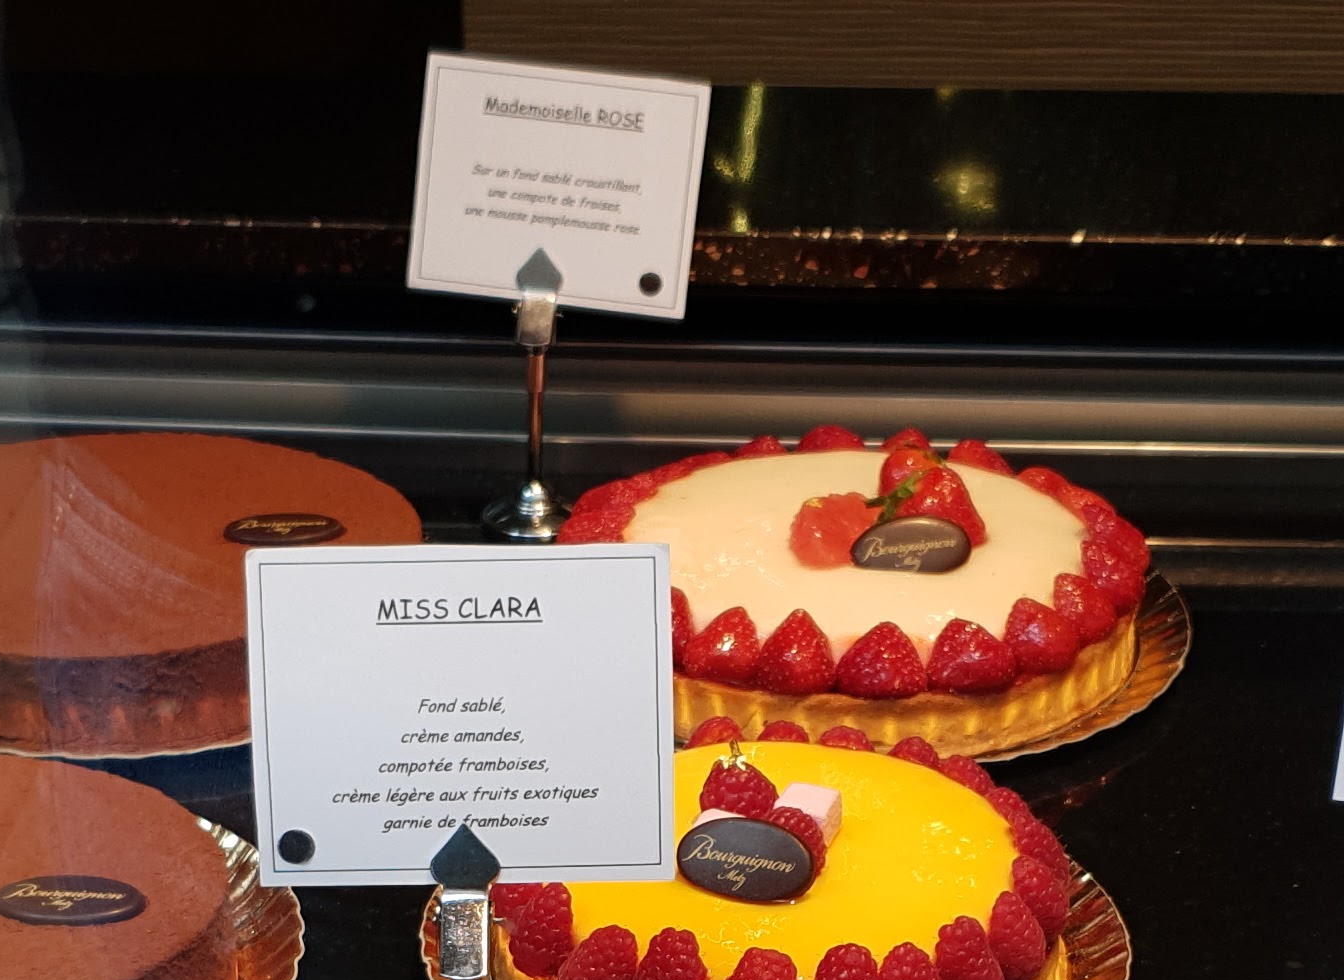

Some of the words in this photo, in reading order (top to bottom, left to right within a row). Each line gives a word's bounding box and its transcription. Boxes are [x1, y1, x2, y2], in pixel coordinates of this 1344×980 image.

[484, 96, 592, 124] Mademoiselle
[596, 107, 645, 130] ROSE
[377, 598, 449, 621] MISS
[458, 596, 541, 620] CLARA
[417, 697, 458, 714] Fond
[460, 696, 506, 715] sablé,
[400, 728, 450, 744] crème
[453, 726, 525, 744] amandes,
[378, 757, 453, 777] compotée
[458, 756, 550, 773] framboises,
[331, 788, 381, 804] crème
[385, 787, 435, 807] légère
[439, 790, 469, 802] aux
[472, 786, 520, 802] fruits
[523, 785, 600, 803] exotiques
[381, 815, 433, 834] garnie
[436, 814, 454, 829] de
[681, 834, 796, 873] Bourguignon
